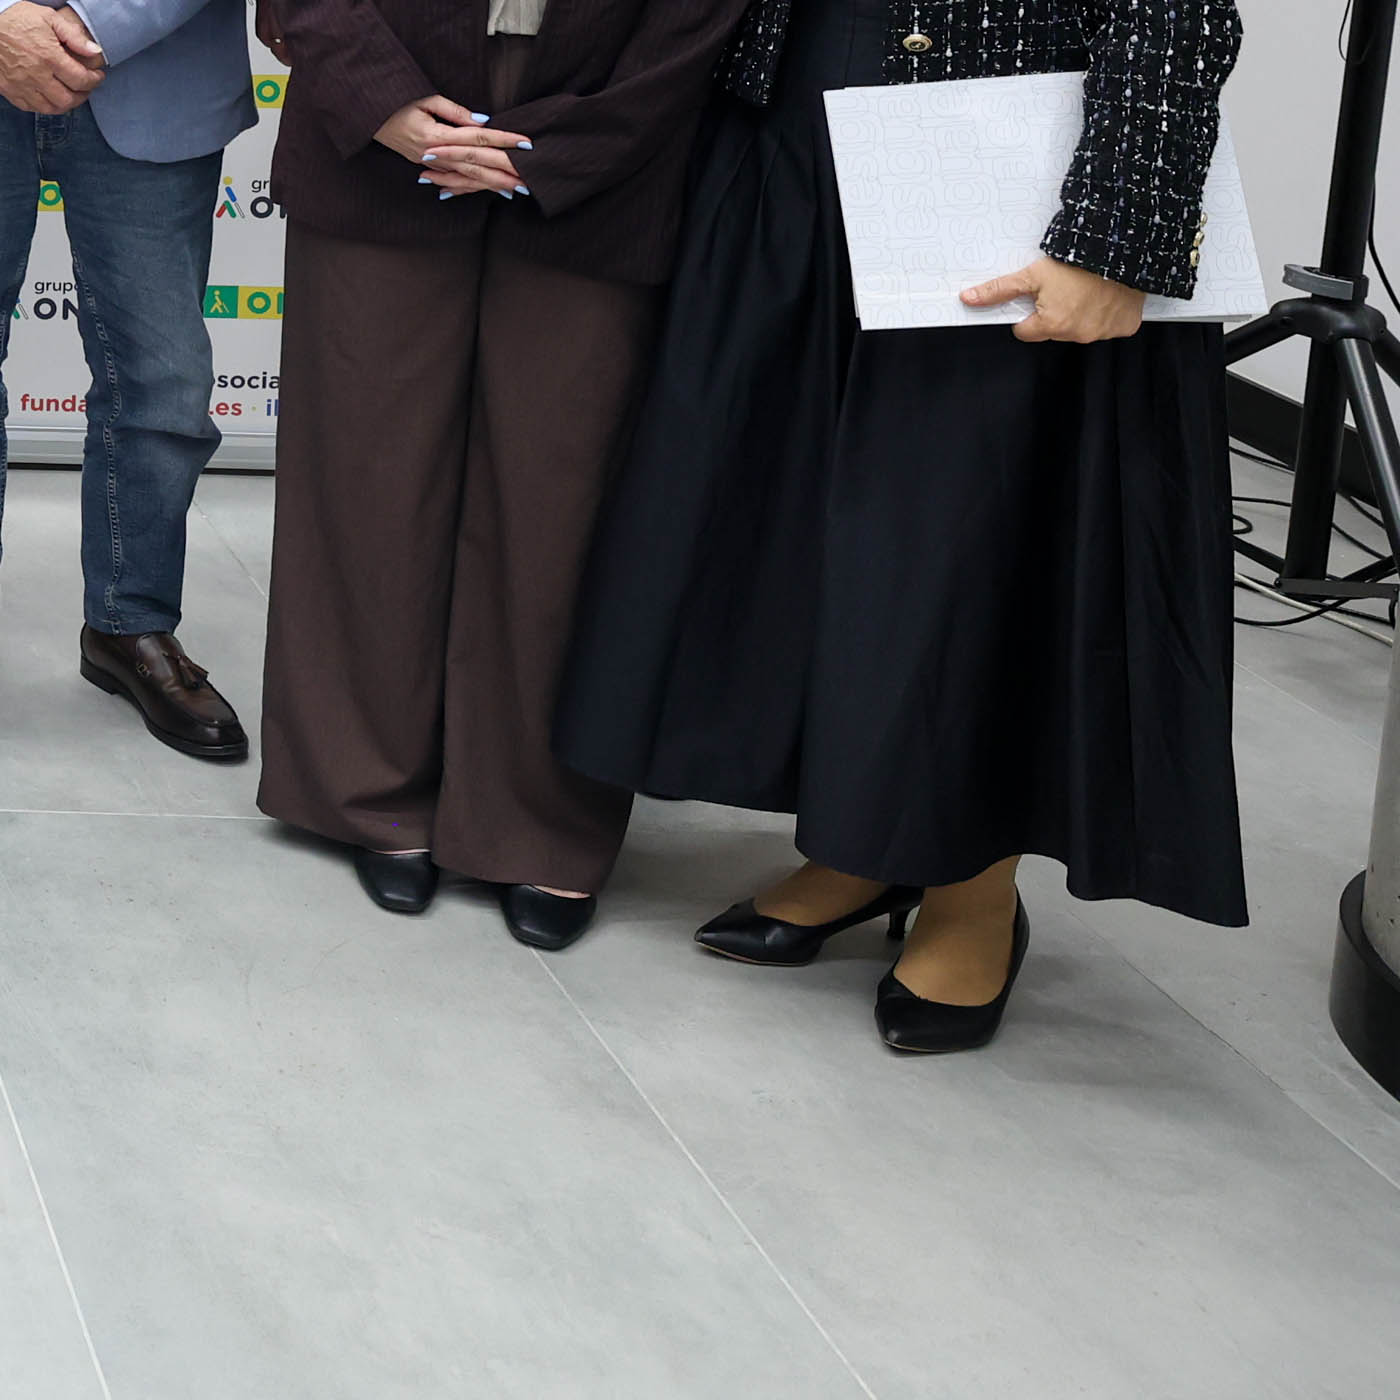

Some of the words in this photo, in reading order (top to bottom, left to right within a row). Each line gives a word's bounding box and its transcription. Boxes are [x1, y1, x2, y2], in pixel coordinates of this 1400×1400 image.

[33, 297, 80, 321] ON
[216, 370, 281, 390] socia
[20, 392, 88, 413] funda
